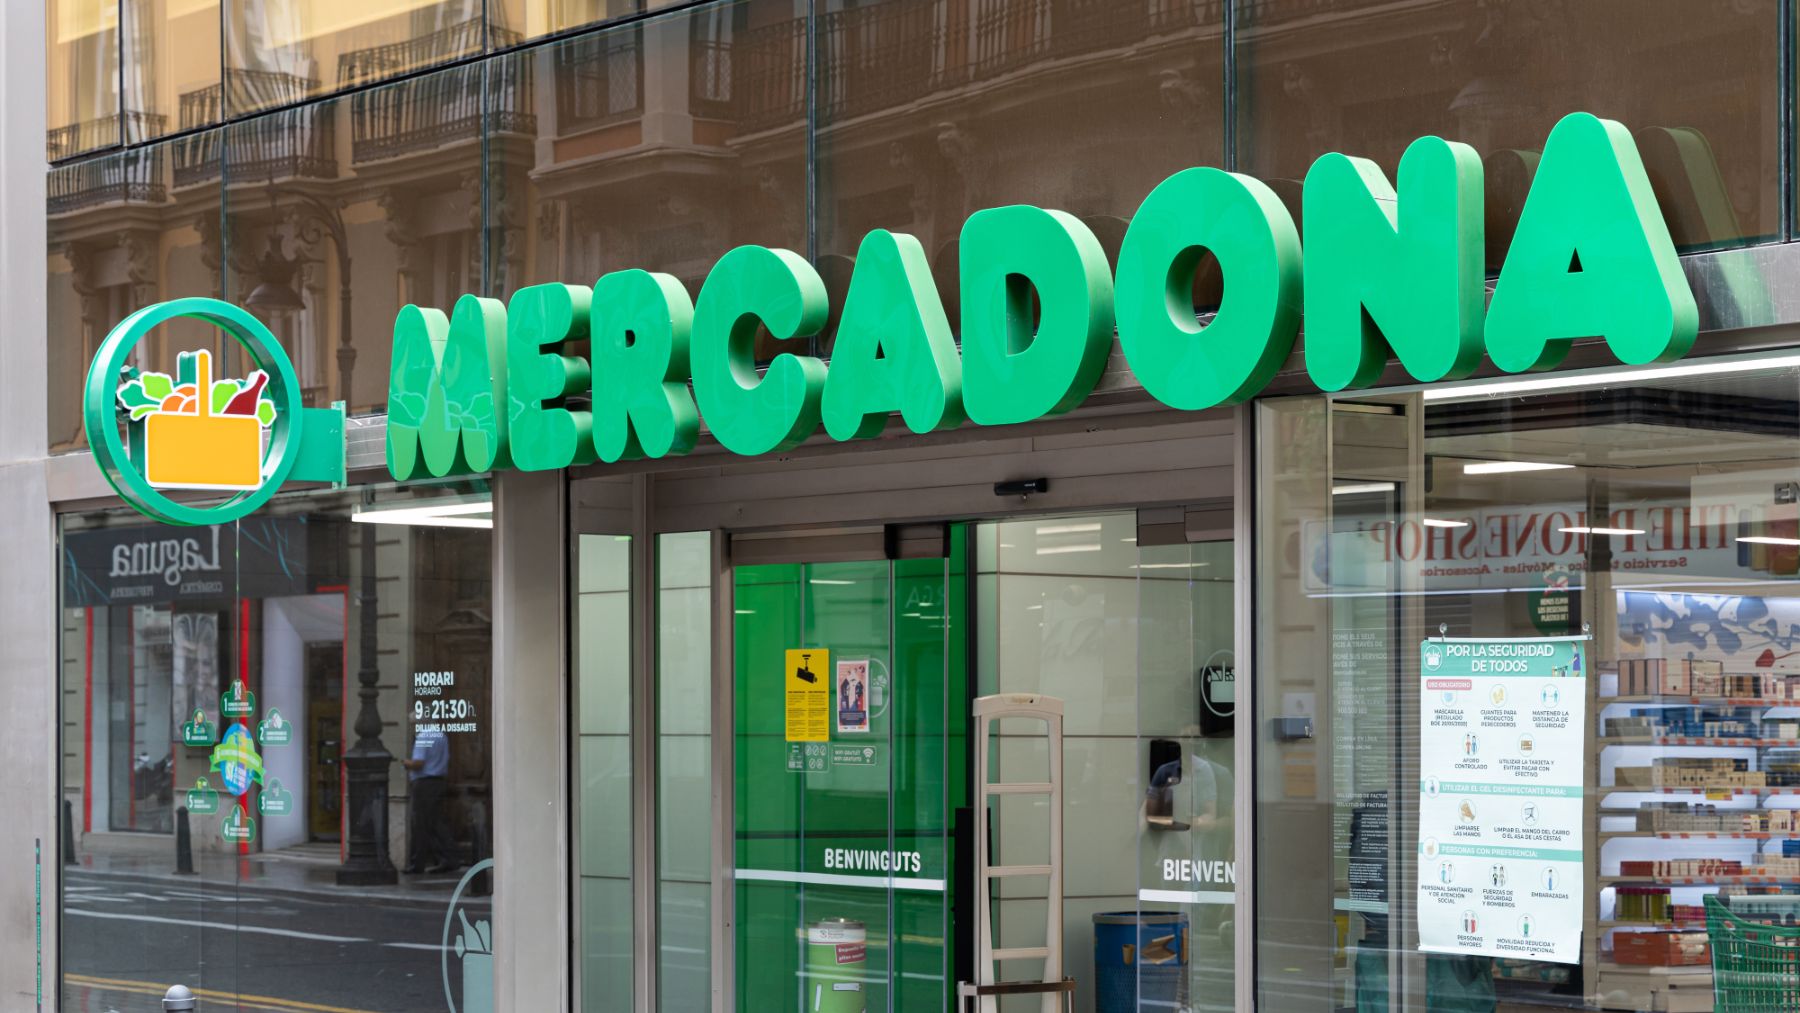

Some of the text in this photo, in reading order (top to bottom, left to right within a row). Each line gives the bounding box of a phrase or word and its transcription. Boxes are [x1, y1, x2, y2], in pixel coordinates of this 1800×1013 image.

[386, 111, 1699, 481] MERCADONA
[1446, 644, 1554, 656] POR LA SEGURIDAD
[1472, 660, 1528, 672] DE TODOS
[414, 672, 454, 686] HORARI
[414, 686, 441, 696] HORARIO
[415, 700, 423, 719] 9
[186, 726, 190, 740] 6
[415, 724, 440, 732] DILLUNS
[447, 723, 477, 732] DISSABTE
[824, 848, 920, 872] BENVINGUTS
[1492, 849, 1537, 857] PREFERENCIA:
[1163, 859, 1235, 883] BIENVEN
